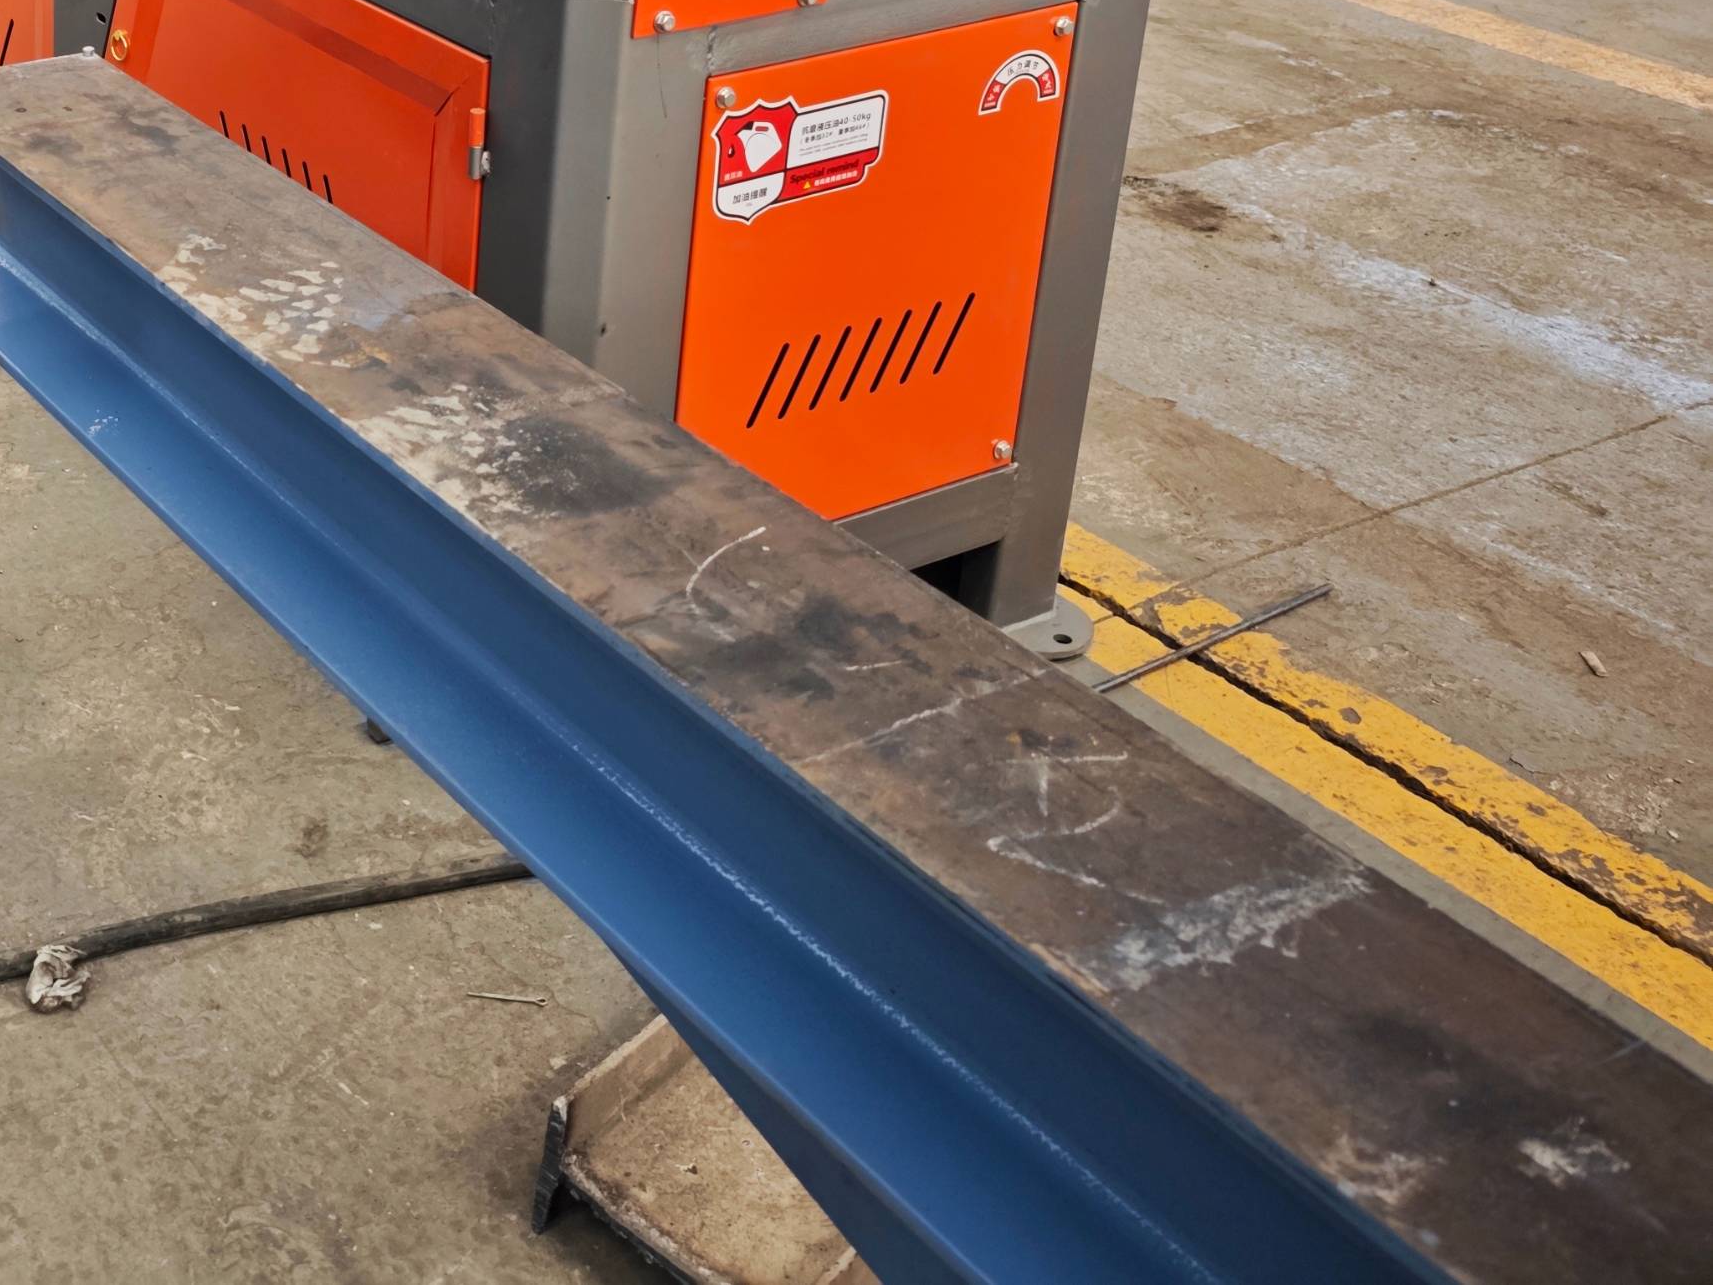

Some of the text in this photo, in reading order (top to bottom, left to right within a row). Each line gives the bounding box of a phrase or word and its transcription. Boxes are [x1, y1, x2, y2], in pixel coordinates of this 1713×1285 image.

[790, 166, 826, 185] Special
[732, 187, 768, 205] 加油提醒
